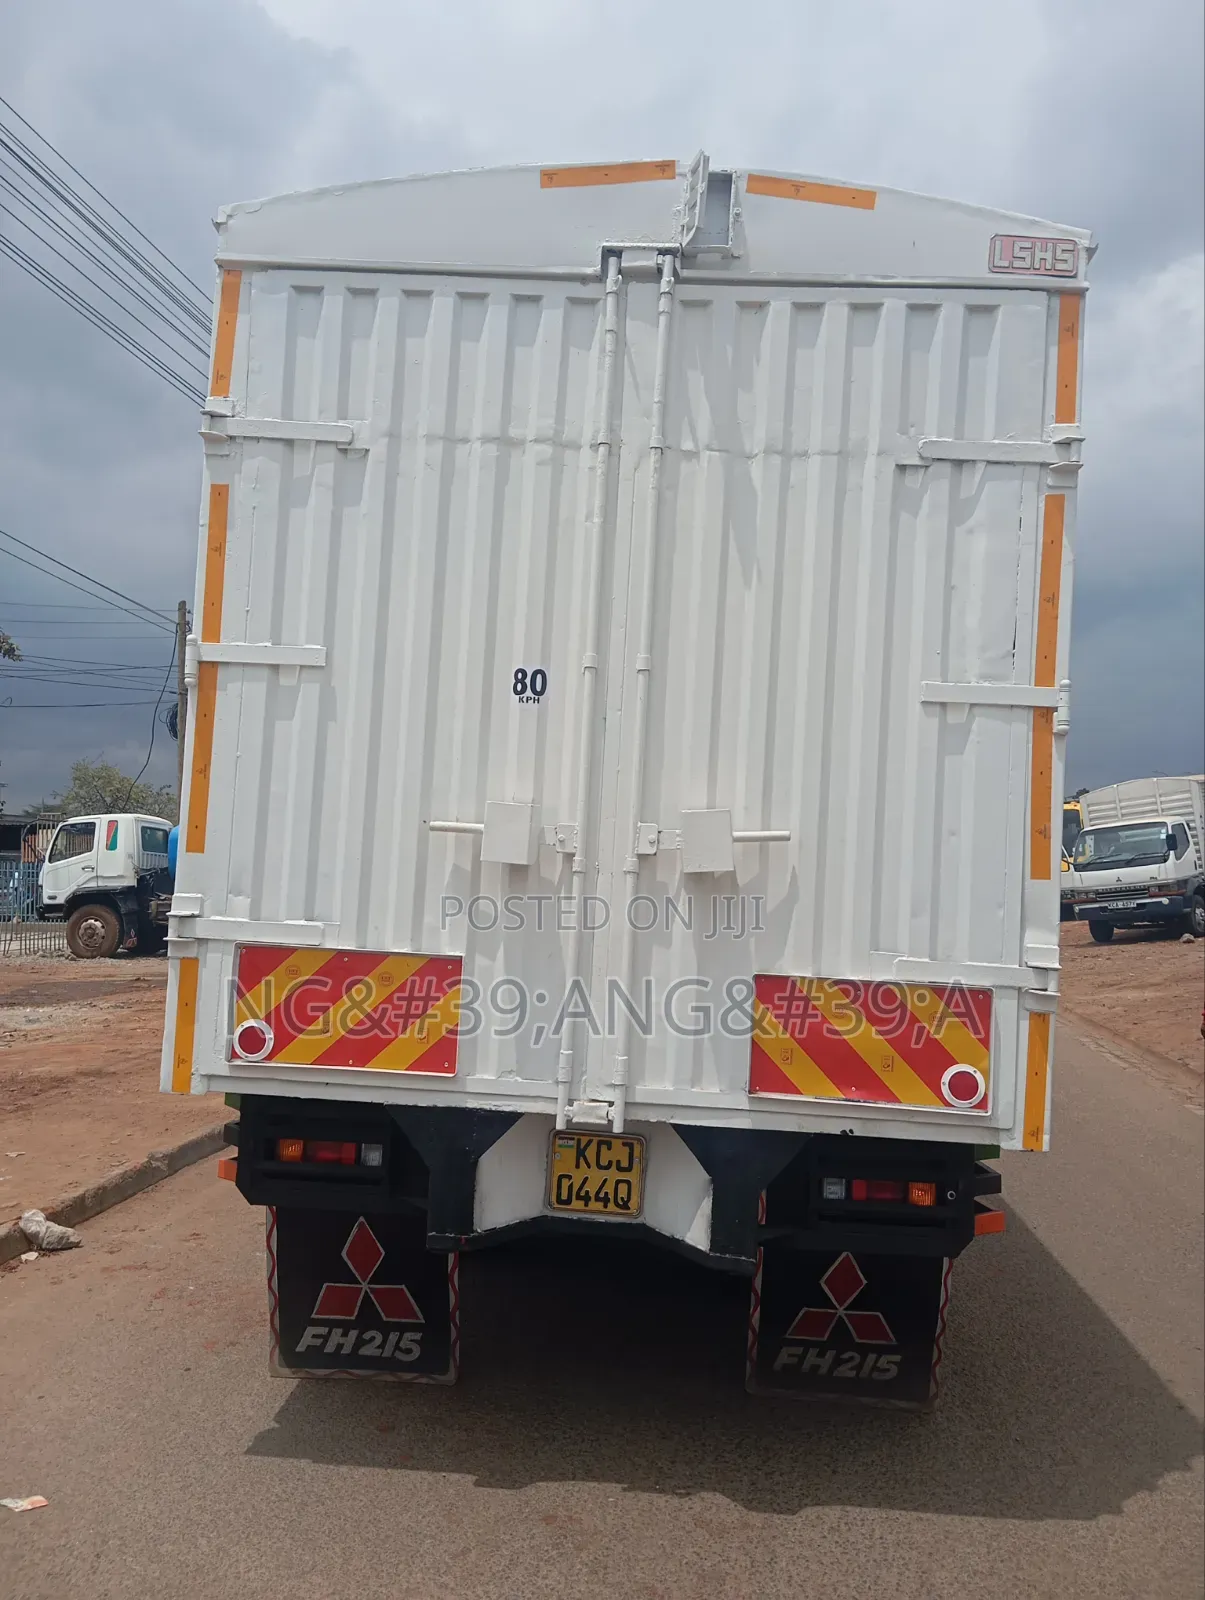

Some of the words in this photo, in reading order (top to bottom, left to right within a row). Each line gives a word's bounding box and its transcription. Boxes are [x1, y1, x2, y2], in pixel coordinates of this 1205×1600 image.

[992, 239, 1076, 272] LSHS
[513, 668, 547, 696] 80
[518, 696, 540, 704] KPH
[575, 1138, 634, 1172] KCJ
[556, 1174, 632, 1210] 044Q
[295, 1326, 422, 1362] FH215
[773, 1346, 902, 1380] FH215
